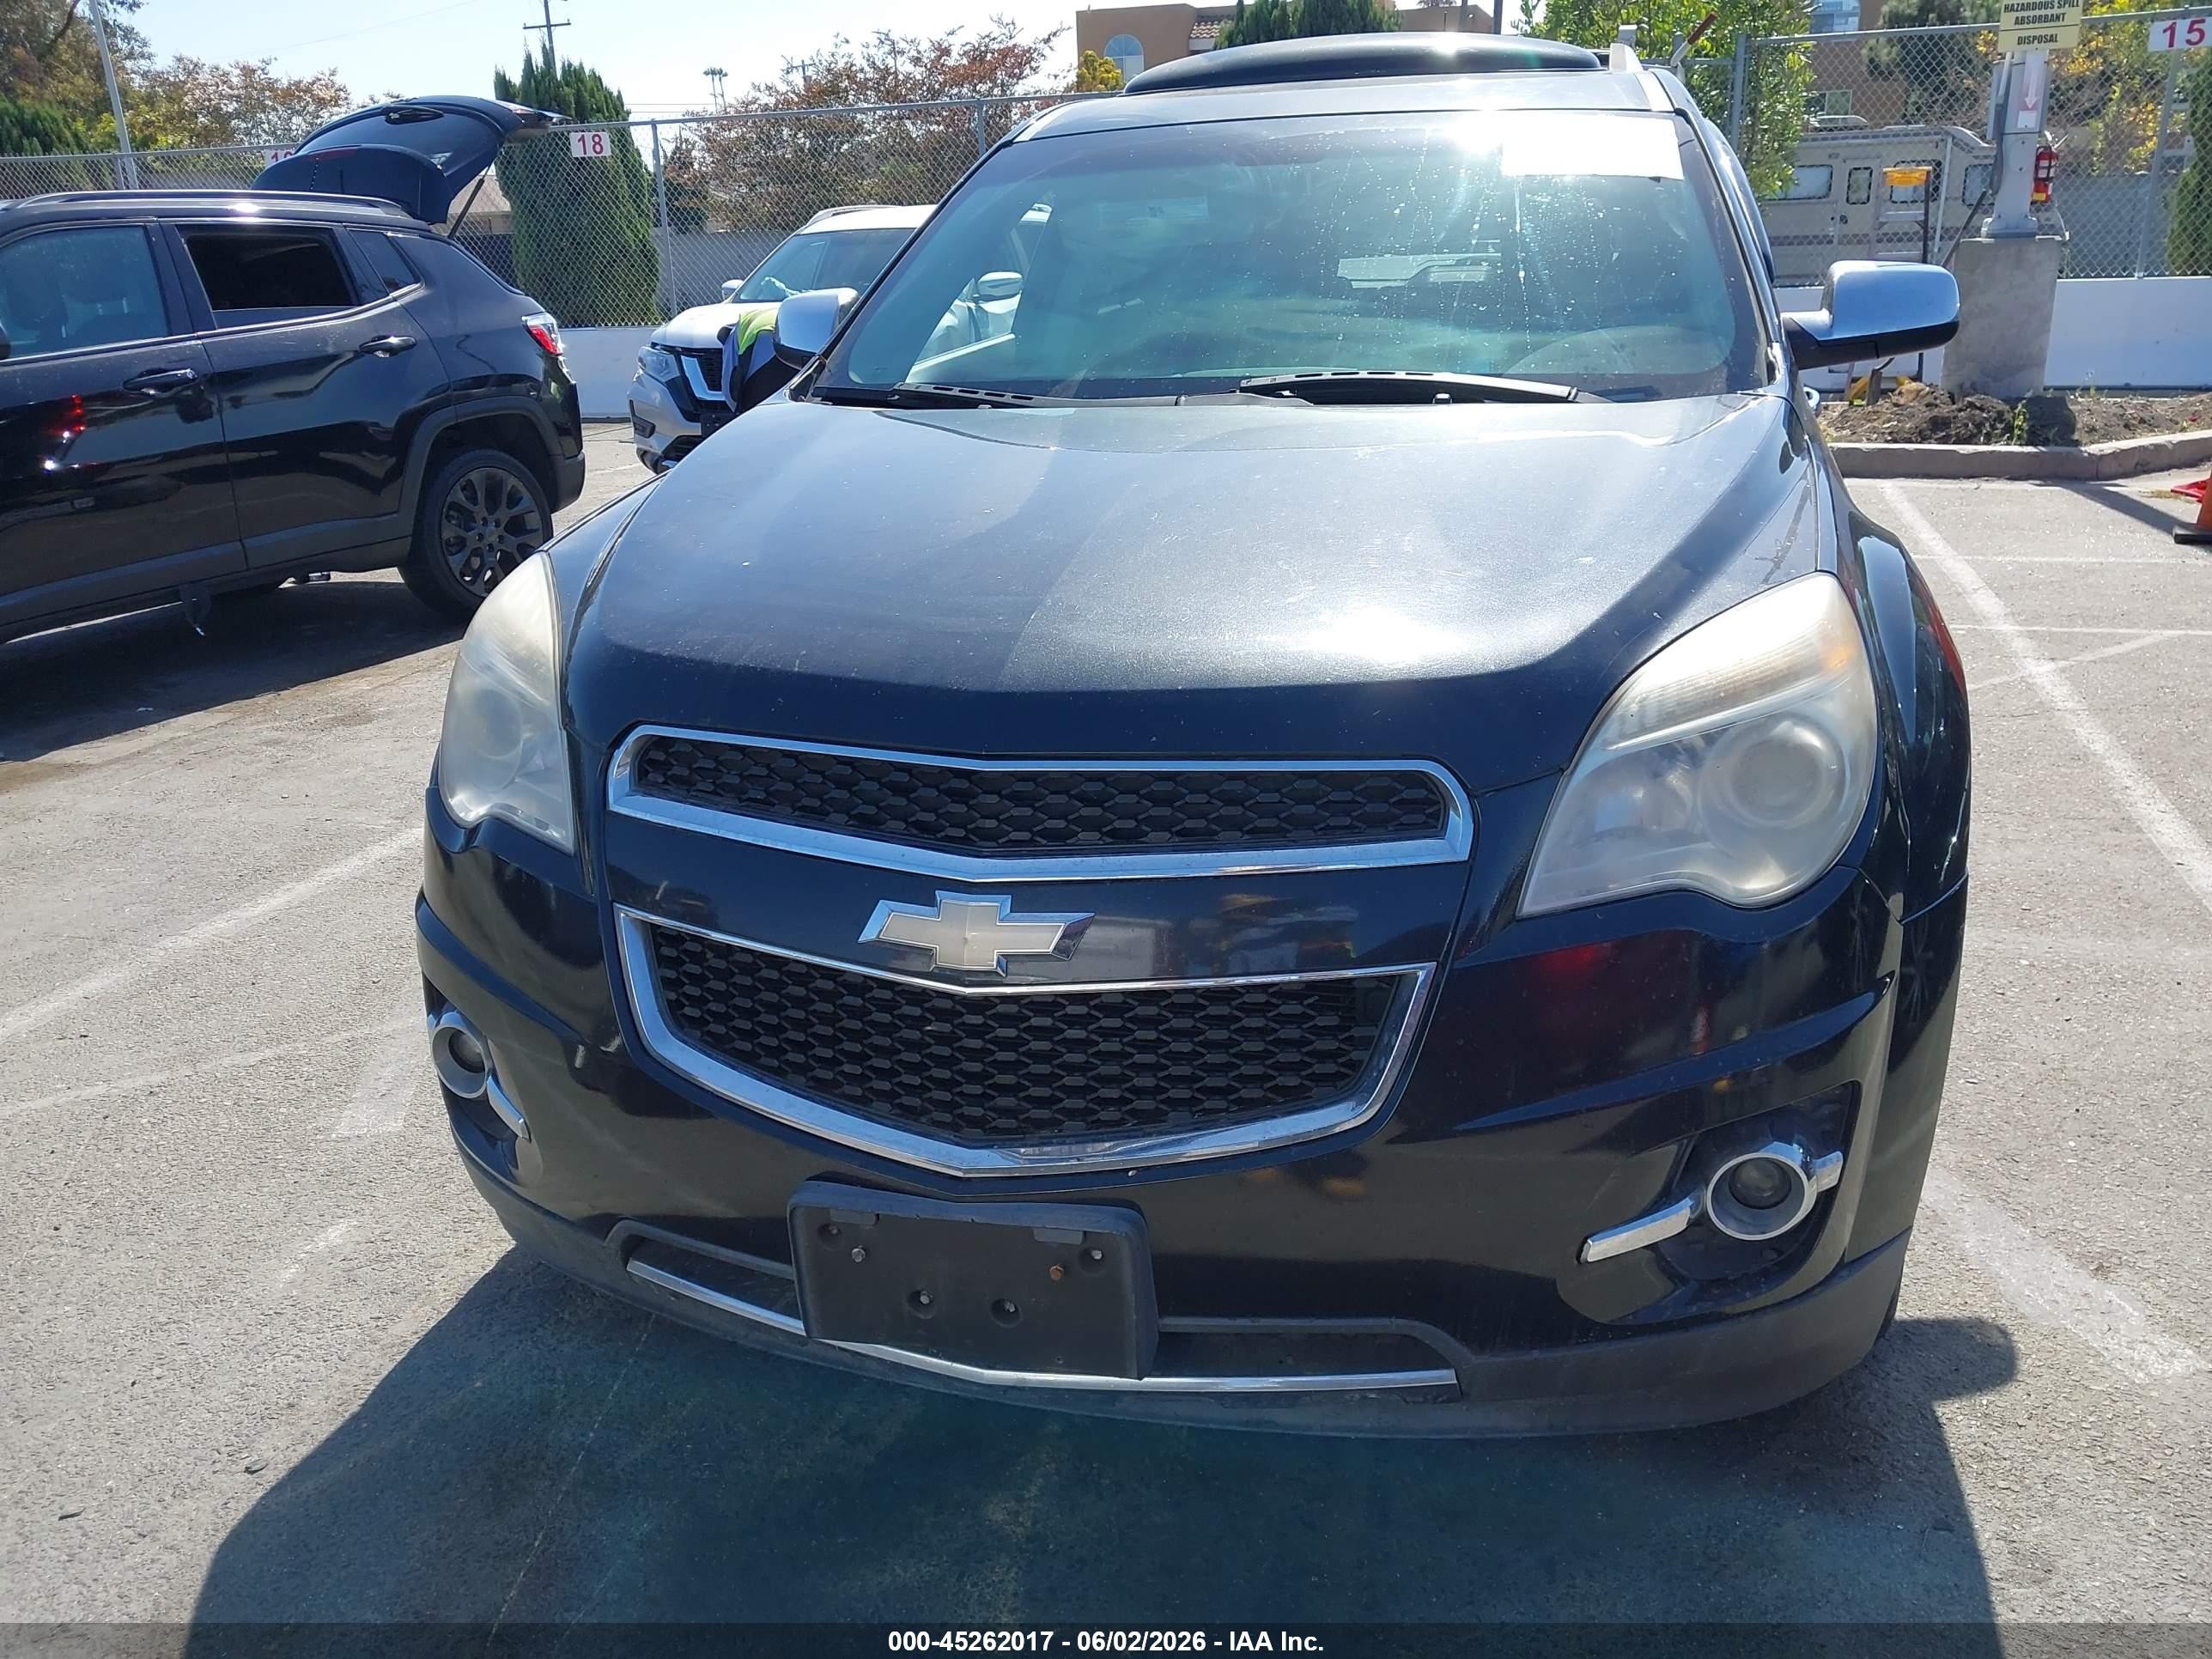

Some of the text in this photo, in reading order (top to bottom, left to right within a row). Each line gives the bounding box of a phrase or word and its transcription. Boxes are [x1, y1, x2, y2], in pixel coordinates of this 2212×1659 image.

[2003, 0, 2080, 13] HAZARDOUS SPILL
[2014, 13, 2066, 25] ABSORBANT
[2017, 33, 2058, 46] DISPOSAL
[2162, 19, 2206, 48] 15
[577, 133, 604, 155] 18
